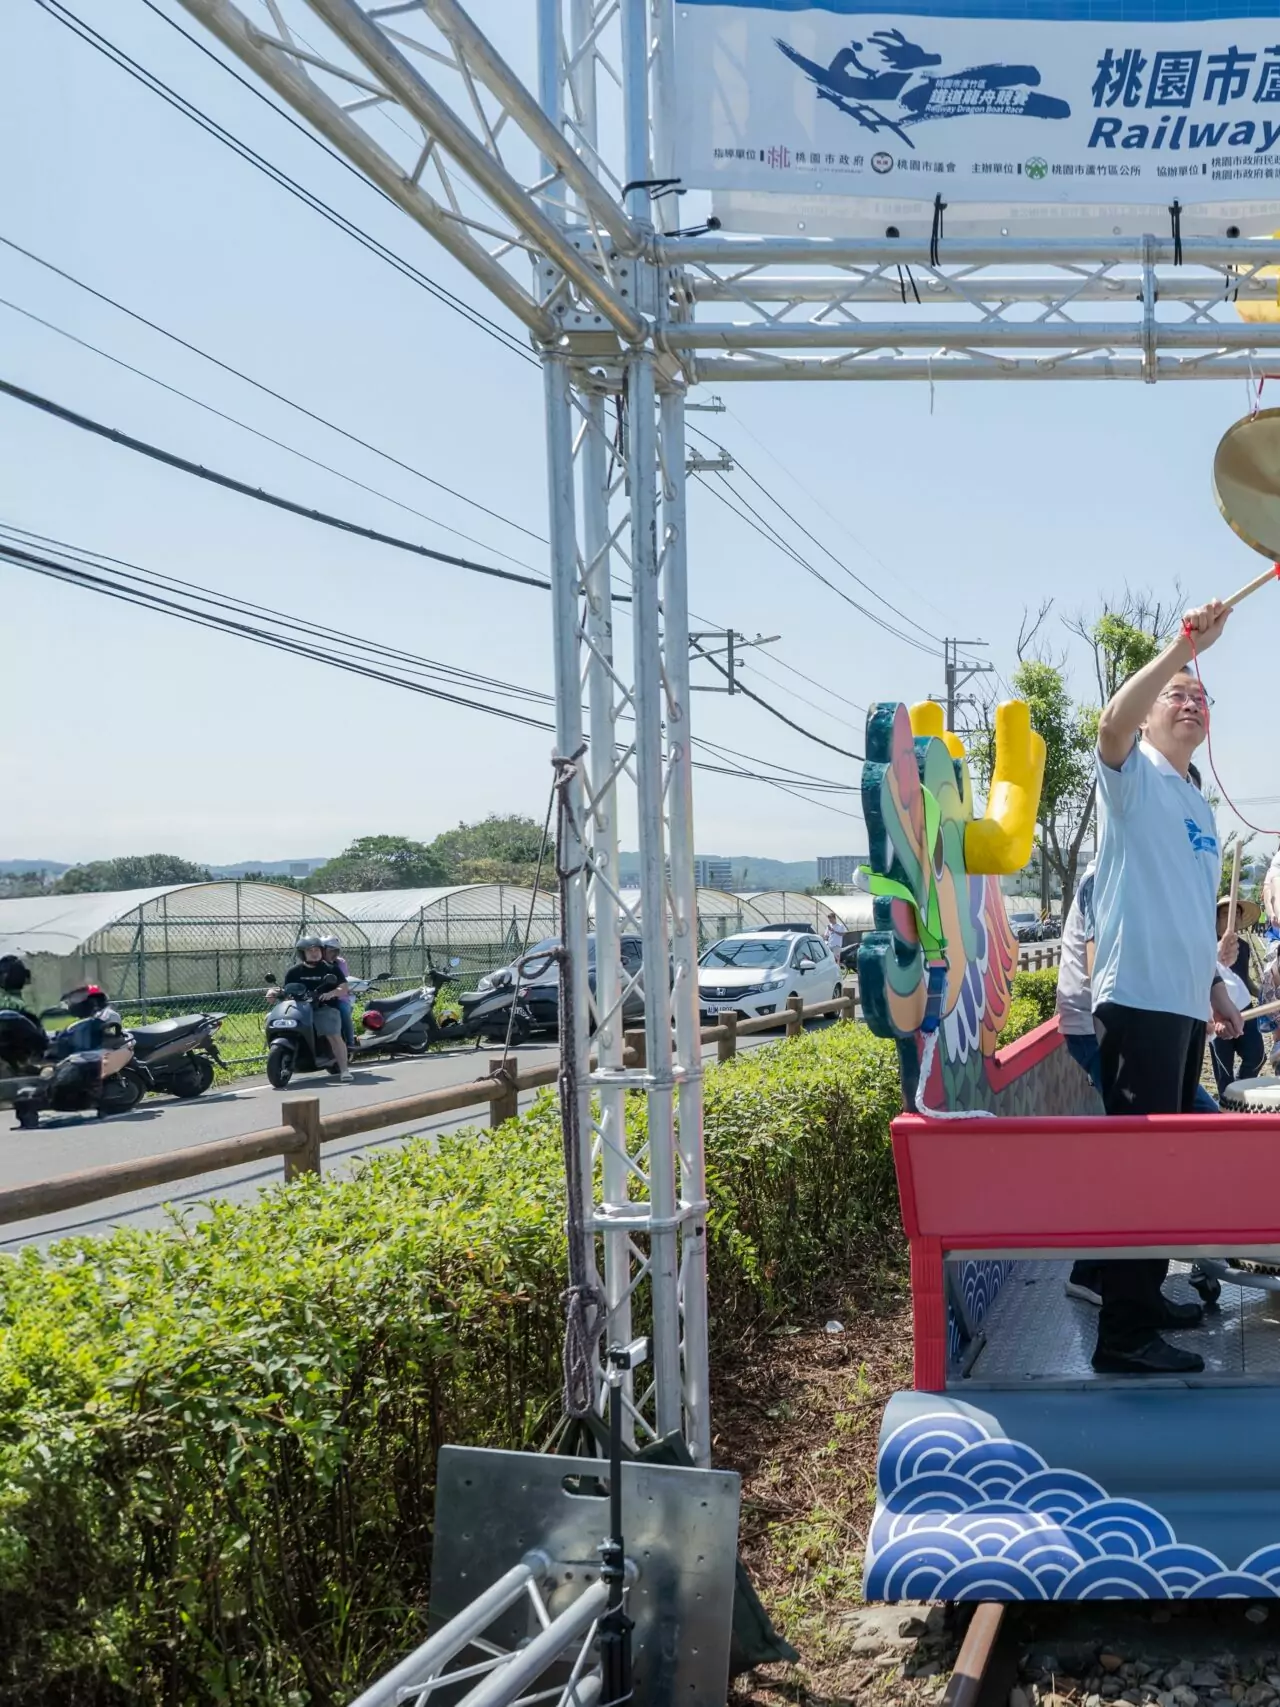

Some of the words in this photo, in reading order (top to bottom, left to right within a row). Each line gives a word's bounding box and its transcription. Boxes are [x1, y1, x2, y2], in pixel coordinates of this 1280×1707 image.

[925, 104, 955, 114] Railway
[957, 104, 985, 115] Dragon
[986, 105, 1004, 113] Boat
[1005, 106, 1024, 114] Race
[714, 148, 756, 161] 指導單位
[795, 152, 864, 167] 桃園市政府
[897, 158, 956, 173] 桃園市議會
[971, 162, 1013, 174] 主辦單位
[1051, 164, 1141, 177] 桃園市蘆竹區公所
[1157, 164, 1198, 177] 協辦單位
